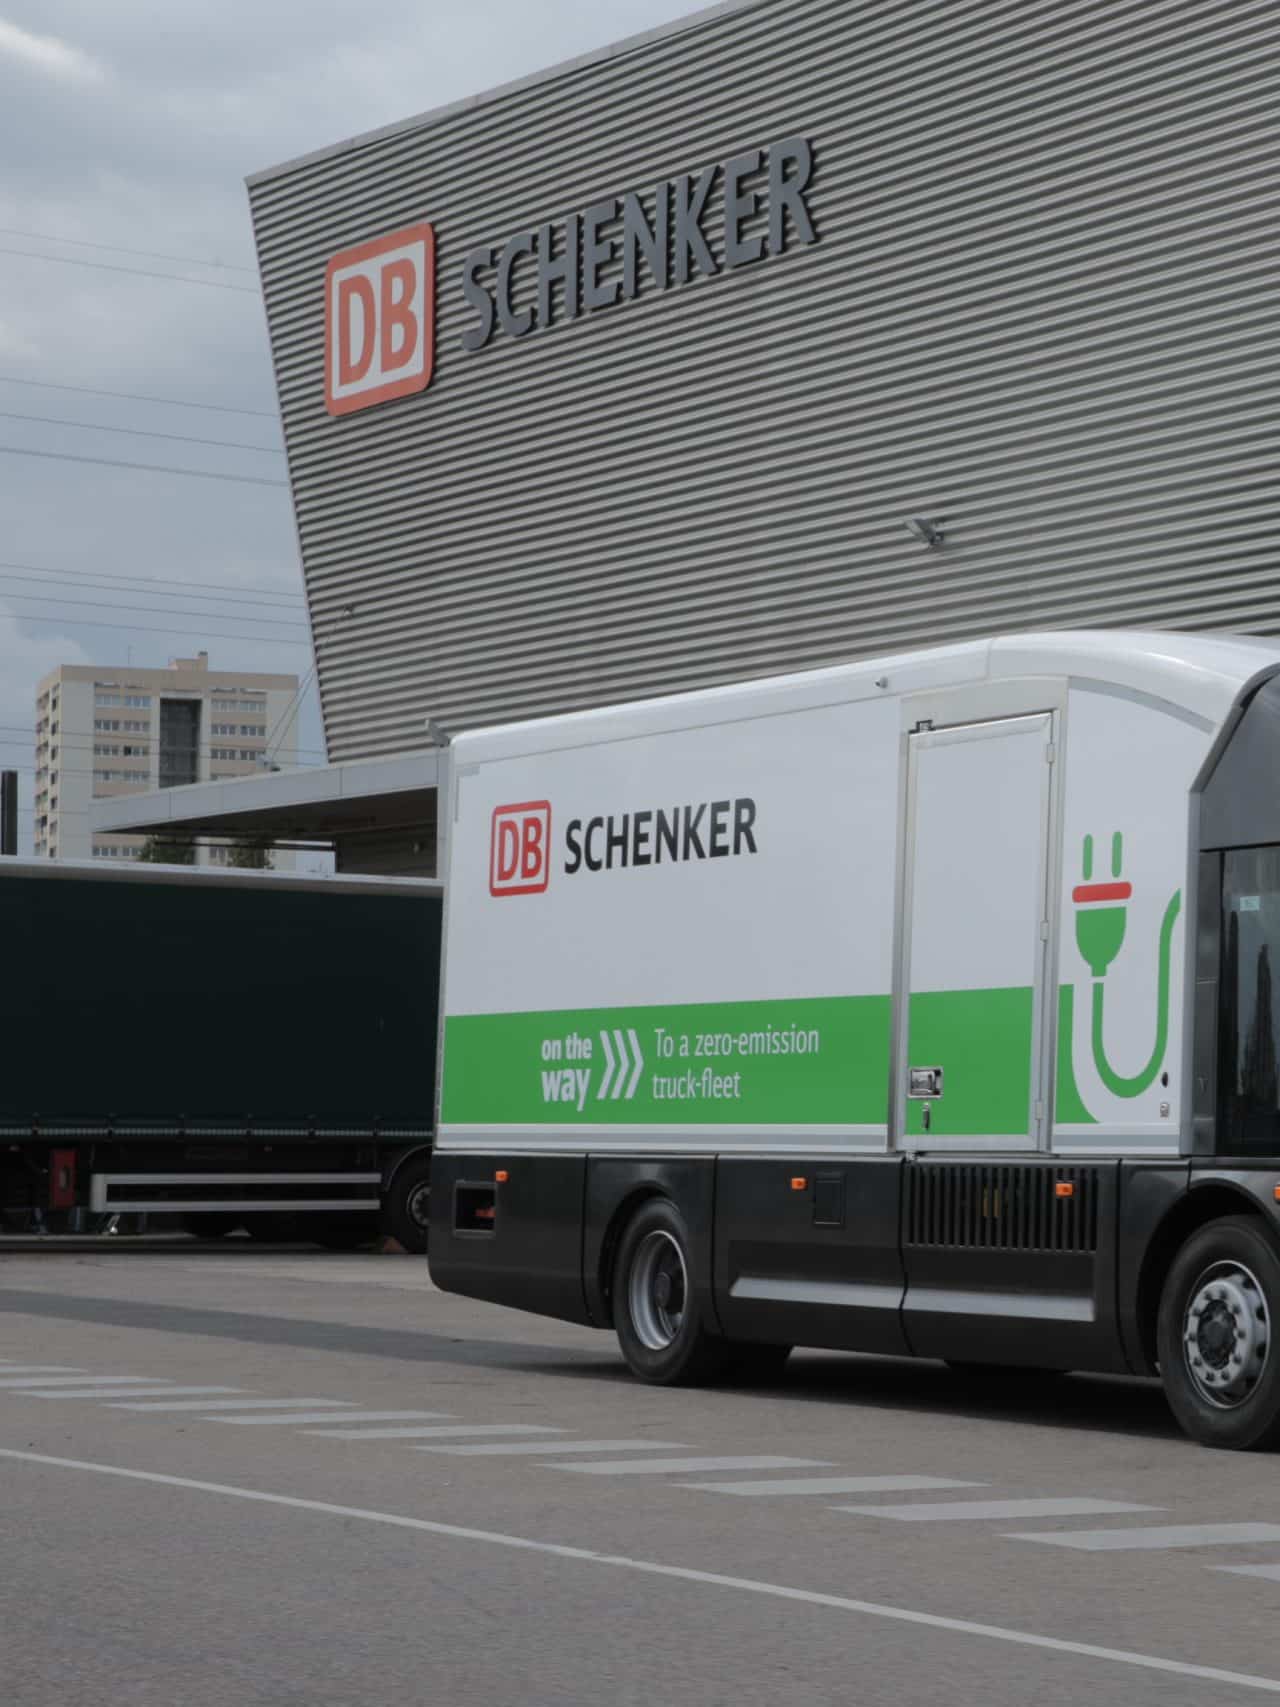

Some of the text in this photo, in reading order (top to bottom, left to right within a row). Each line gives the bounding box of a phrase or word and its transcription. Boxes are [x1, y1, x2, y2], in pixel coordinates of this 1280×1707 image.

[338, 135, 820, 387] DB SCHENKER
[496, 798, 758, 882] DB SCHENKER
[541, 1032, 592, 1061] on the
[654, 1023, 820, 1058] To a zero-emission
[541, 1068, 592, 1112] way
[652, 1067, 742, 1099] truck-fleet
